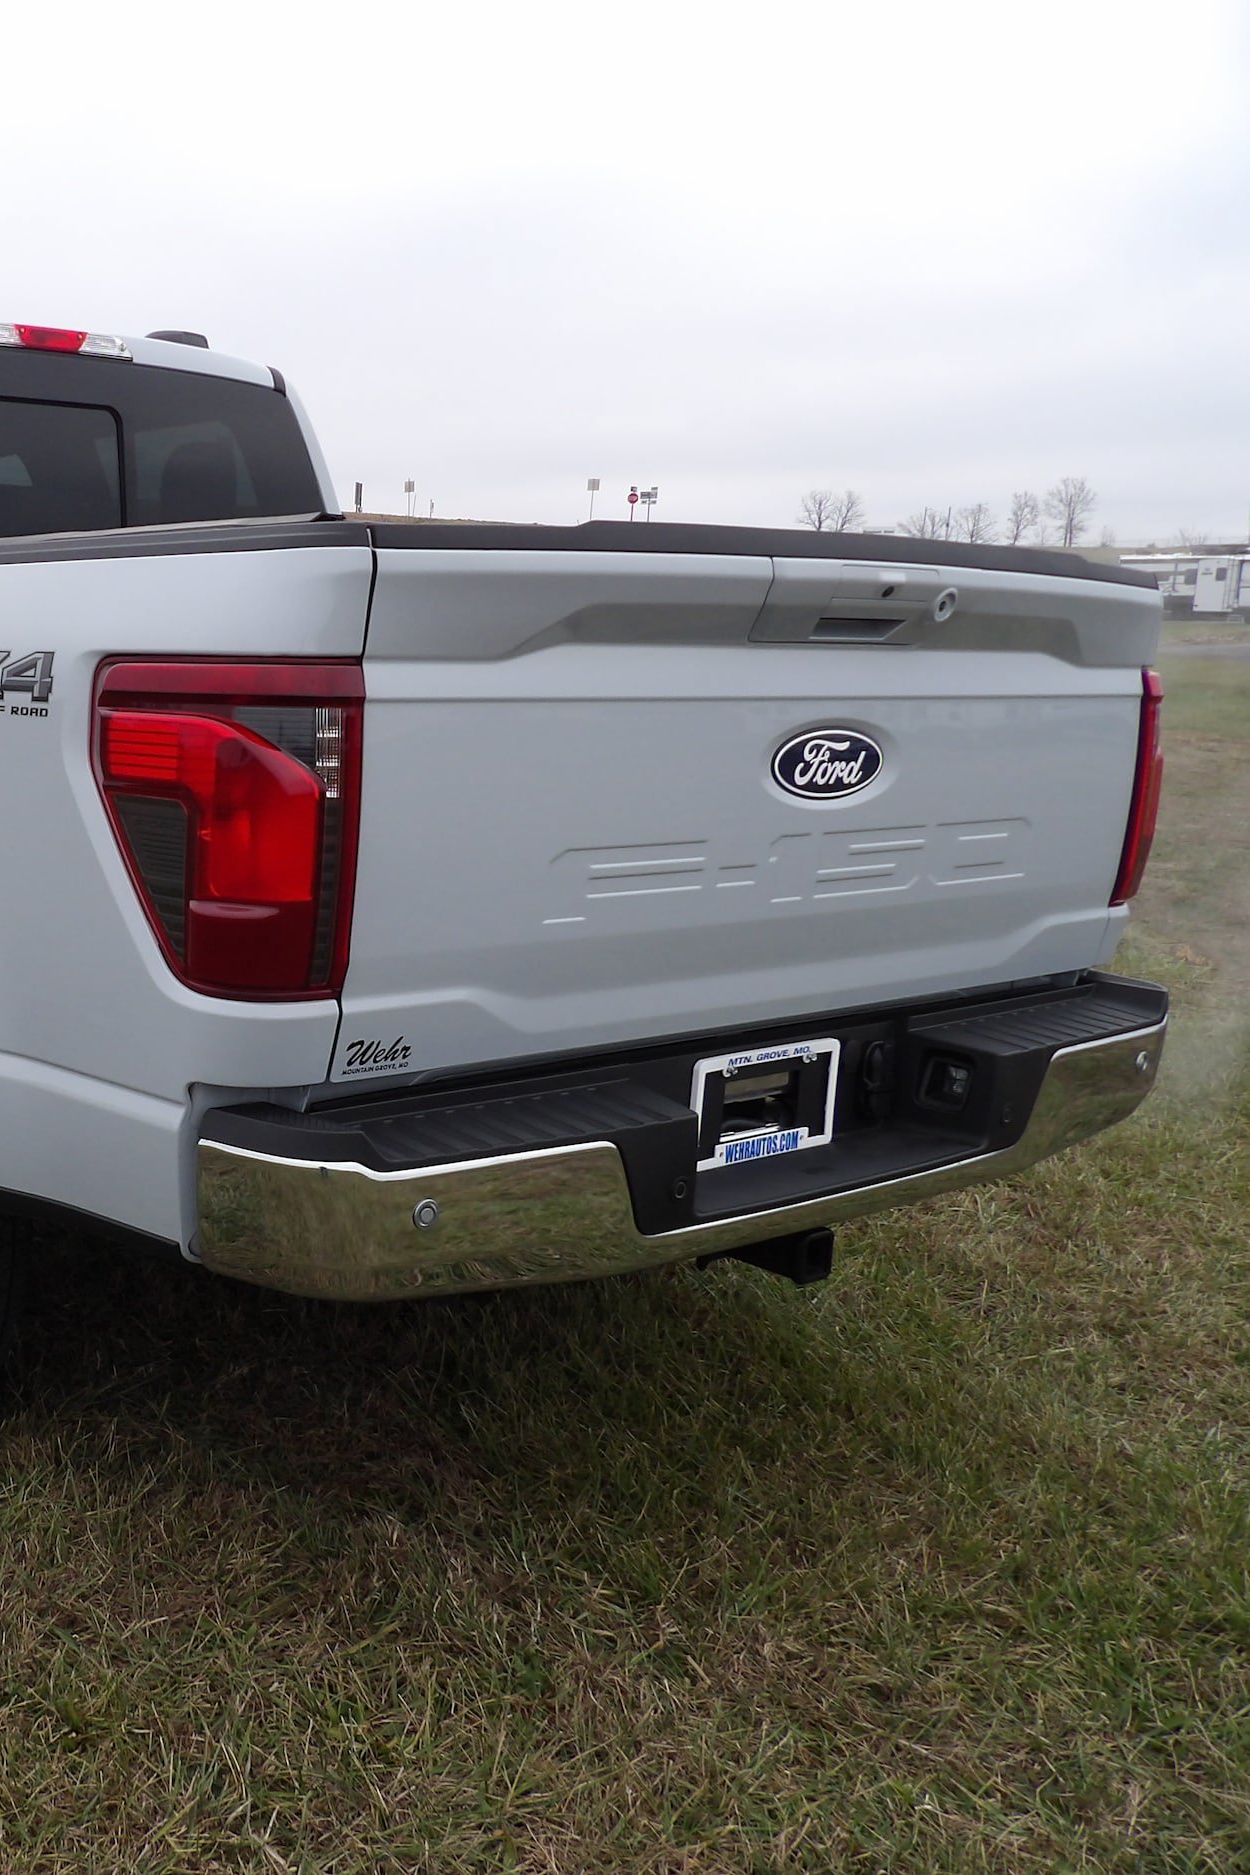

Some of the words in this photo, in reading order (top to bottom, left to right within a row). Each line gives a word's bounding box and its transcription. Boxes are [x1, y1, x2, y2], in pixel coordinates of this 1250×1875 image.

[10, 706, 49, 717] ROAD
[794, 739, 867, 786] Ford
[543, 817, 1033, 925] F-150
[346, 1036, 412, 1067] Wehr
[727, 1056, 753, 1067] MTN.
[793, 1046, 812, 1055] MO.
[342, 1066, 374, 1075] MOUNTAIN
[725, 1130, 799, 1164] WEHRAUTOS.COM
